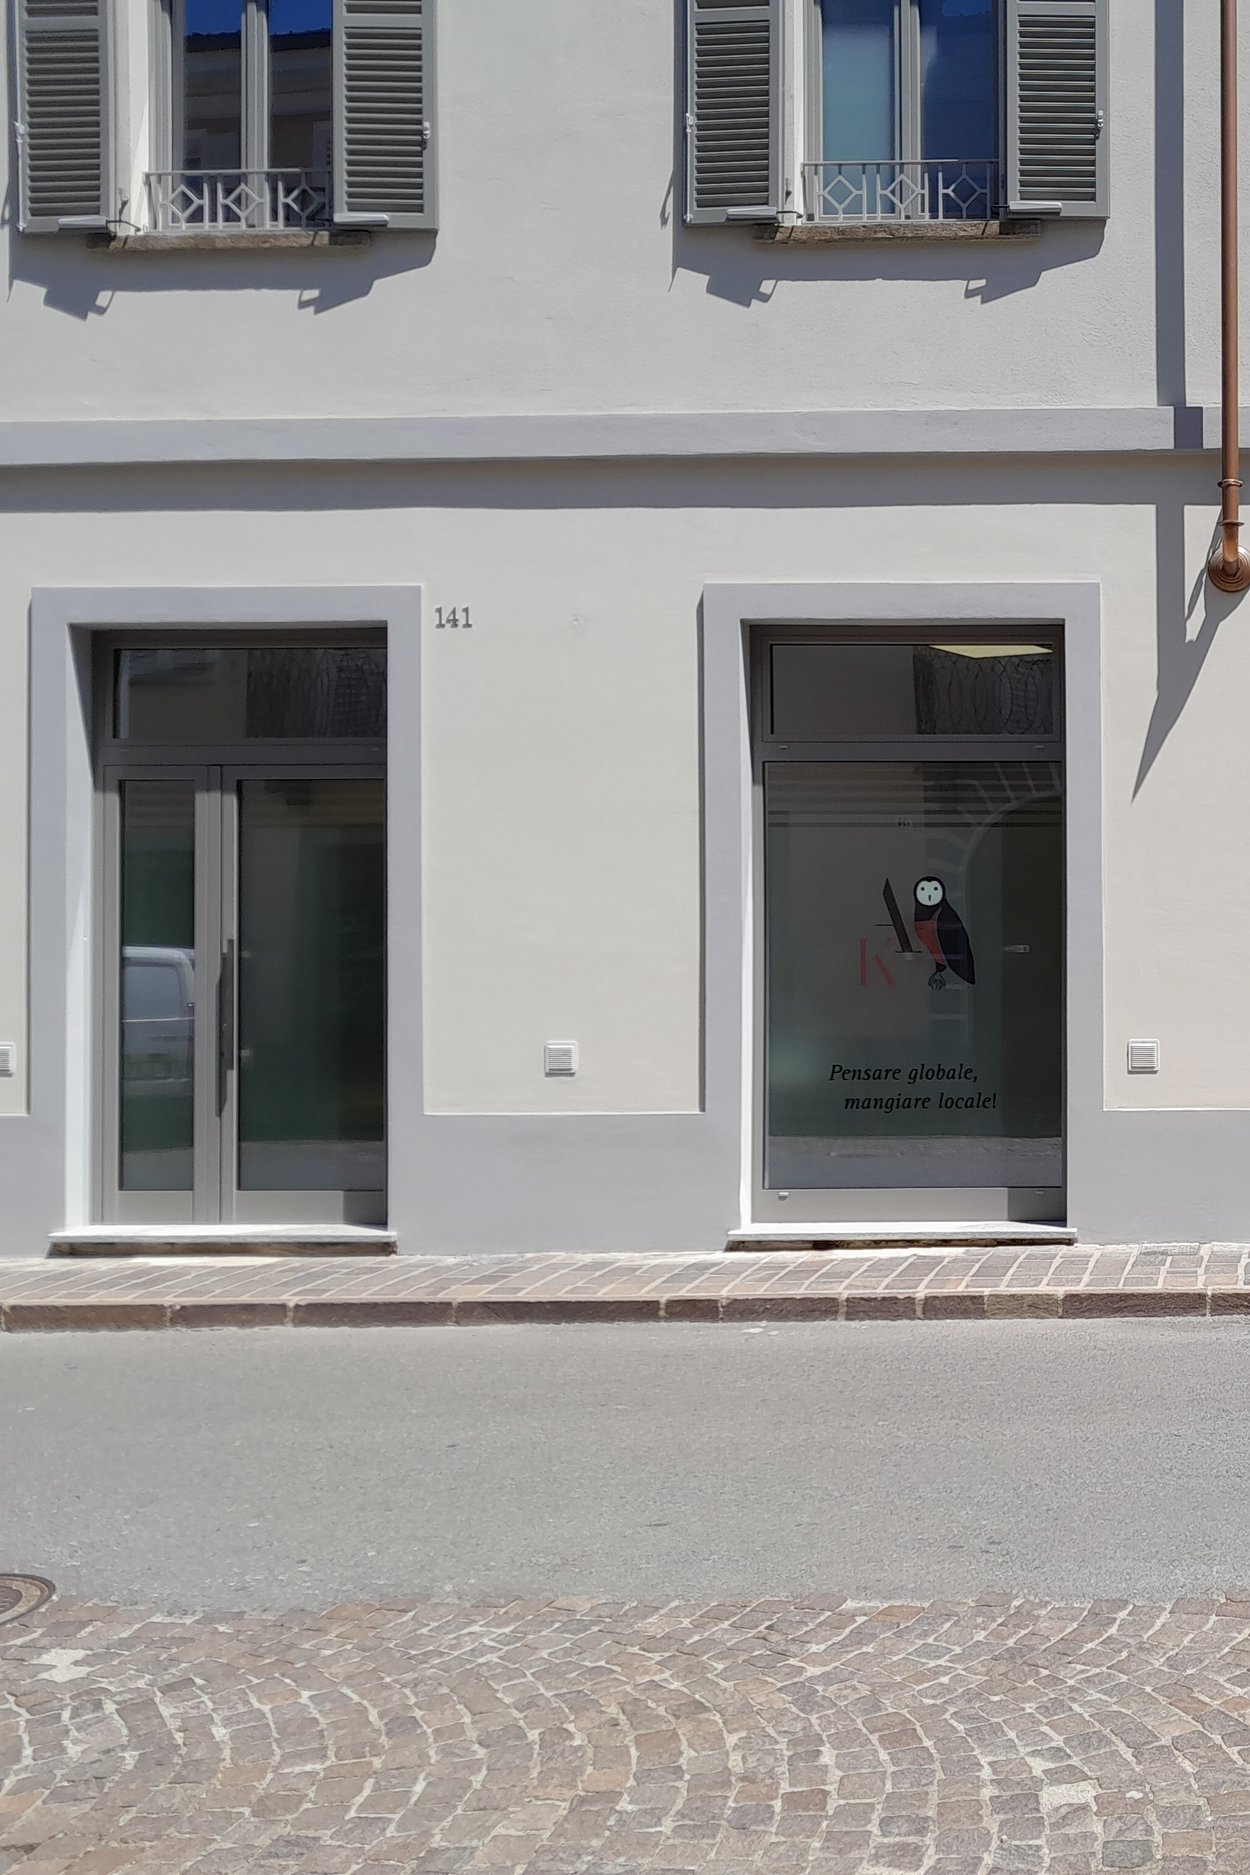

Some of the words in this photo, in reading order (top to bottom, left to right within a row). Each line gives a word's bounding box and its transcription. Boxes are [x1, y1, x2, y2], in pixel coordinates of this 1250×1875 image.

[434, 606, 473, 629] 141
[828, 1064, 902, 1081] Pensare
[907, 1063, 979, 1084] globale,
[844, 1094, 931, 1114] mangiare
[938, 1092, 997, 1110] locale!
